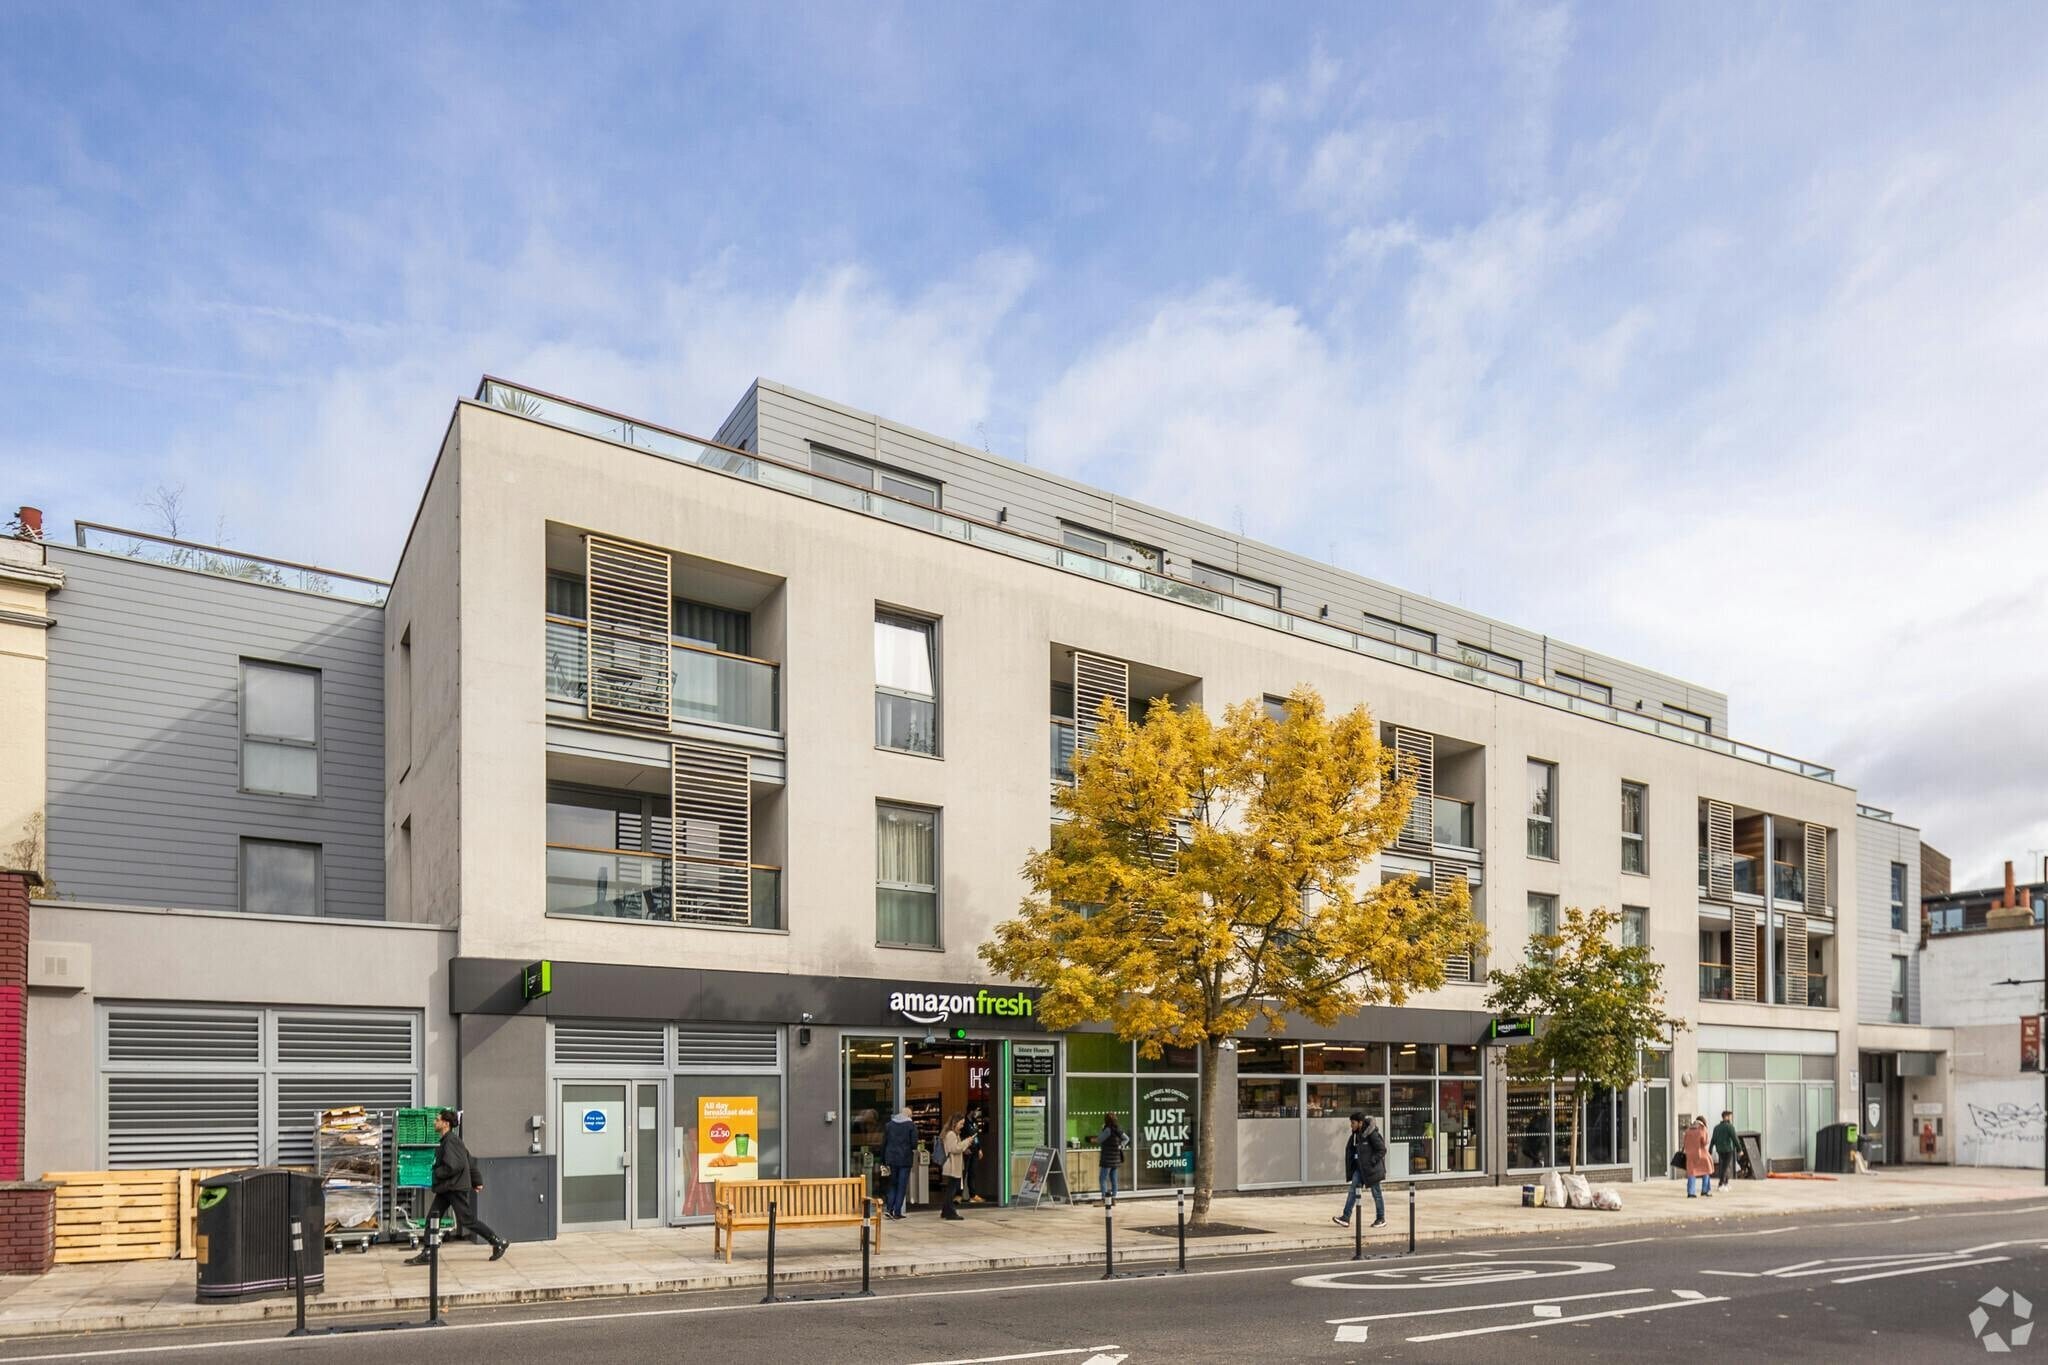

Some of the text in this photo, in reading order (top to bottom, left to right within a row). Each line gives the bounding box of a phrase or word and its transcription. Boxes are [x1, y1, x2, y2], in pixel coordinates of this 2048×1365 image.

[890, 989, 1032, 1016] amazon fresh
[715, 1102, 729, 1112] day
[1147, 1108, 1186, 1124] JUST
[1143, 1125, 1190, 1141] WALK
[1150, 1142, 1184, 1158] OUT
[1146, 1159, 1188, 1169] SHOPPING
